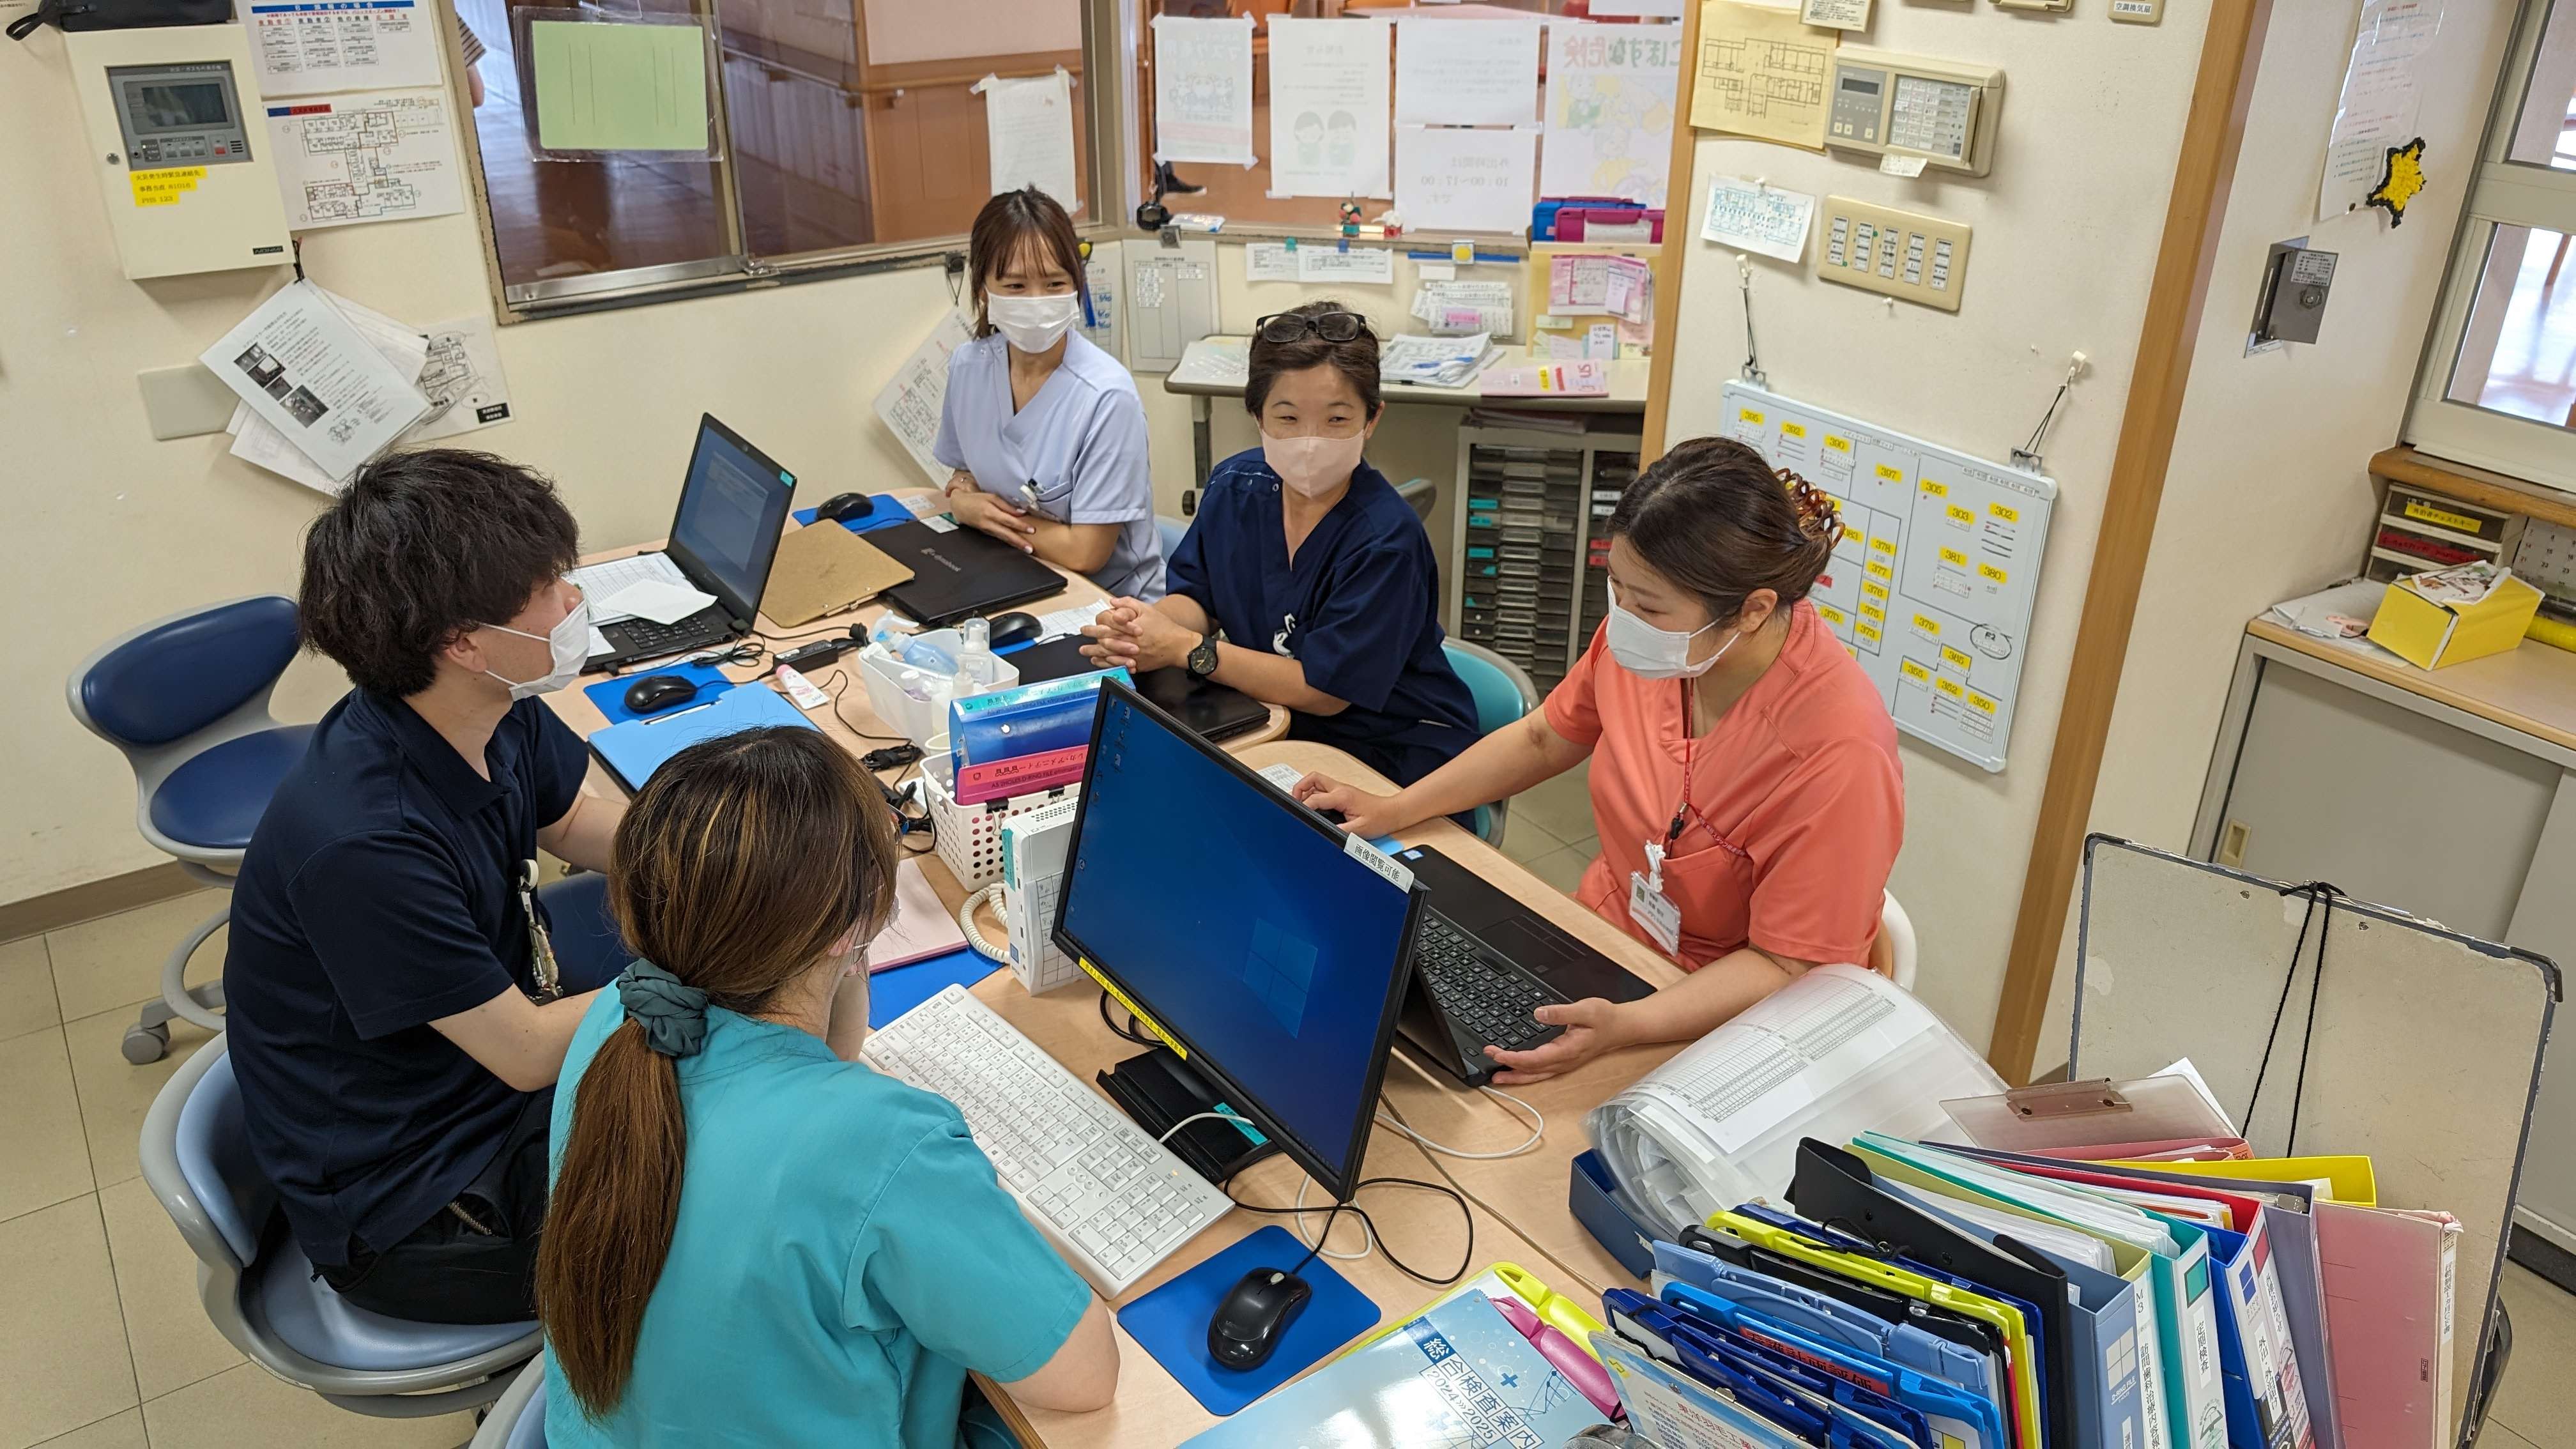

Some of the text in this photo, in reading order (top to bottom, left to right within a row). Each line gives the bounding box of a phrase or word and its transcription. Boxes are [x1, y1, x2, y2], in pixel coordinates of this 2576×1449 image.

[1952, 507, 1969, 521] 303
[1354, 843, 1400, 882] 画像閲覧可能
[2196, 1320, 2209, 1376] 定期検査
[1423, 1338, 1536, 1449] 総合検査案内
